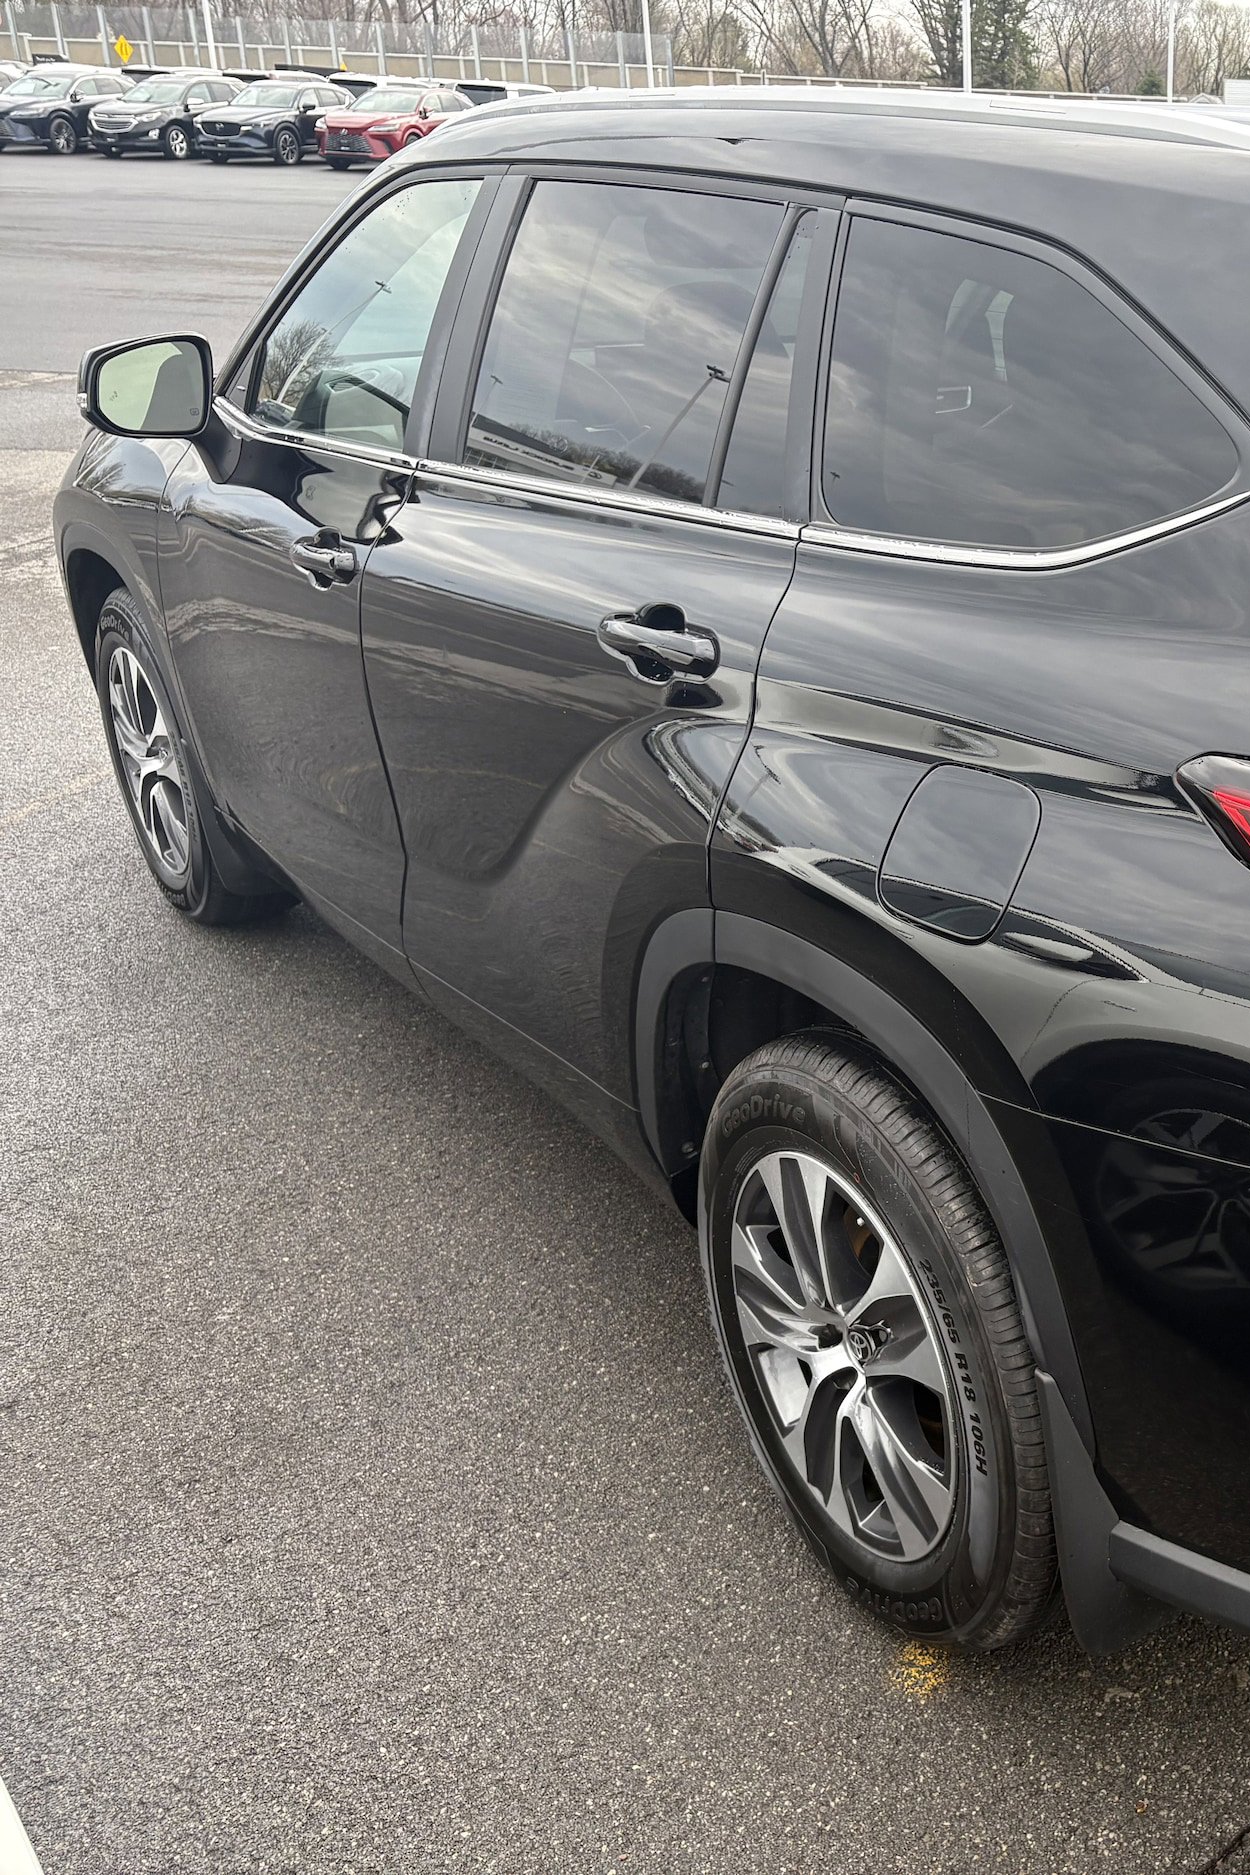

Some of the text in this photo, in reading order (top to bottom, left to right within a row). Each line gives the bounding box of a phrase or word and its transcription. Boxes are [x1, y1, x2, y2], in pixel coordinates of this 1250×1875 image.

[721, 1093, 806, 1138] GeoDrive
[919, 1257, 988, 1477] 235/65 R18 106H
